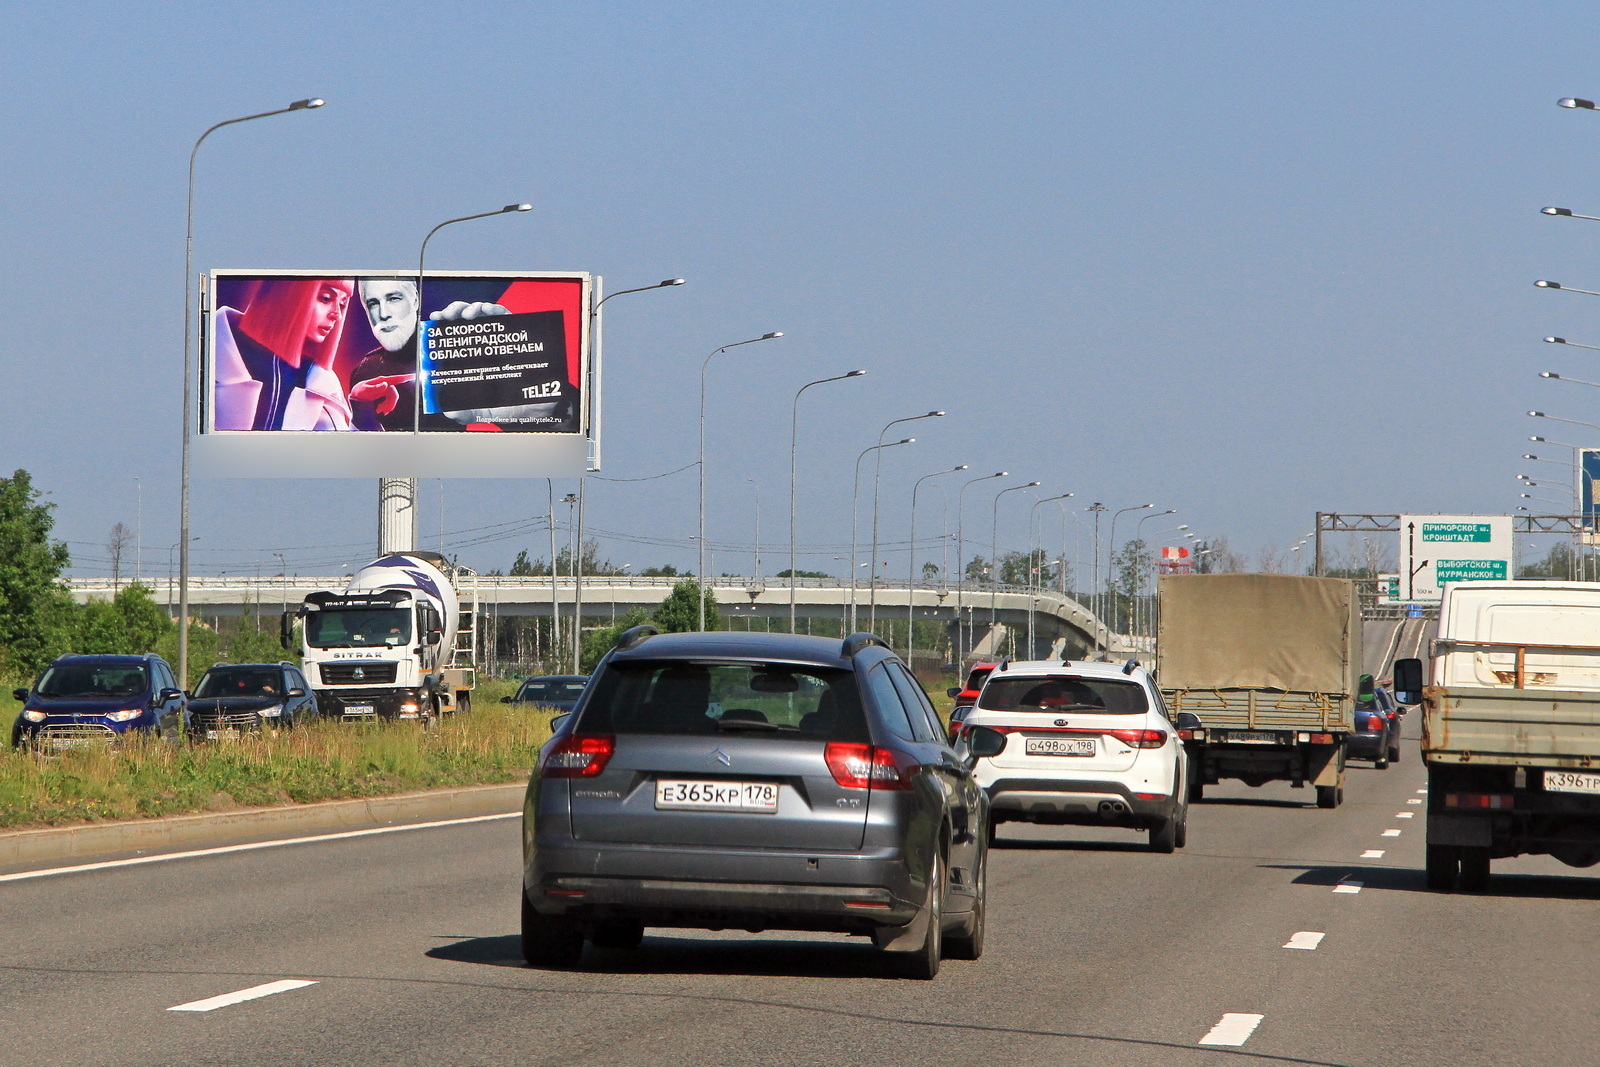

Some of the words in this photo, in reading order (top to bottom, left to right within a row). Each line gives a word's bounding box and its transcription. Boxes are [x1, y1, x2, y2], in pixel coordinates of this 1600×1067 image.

[428, 328, 442, 338] ЗА
[445, 323, 505, 337] СКОРОСТЬ
[429, 340, 436, 349] В
[439, 330, 528, 349] ЛЕНИГРАДСКОЙ
[430, 347, 482, 361] ОБЛАСТИ
[485, 342, 544, 358] ОТВЕЧАЕМ
[431, 369, 462, 377] Качество
[464, 365, 500, 377] интернета
[502, 362, 549, 372] обеспечивает
[431, 374, 484, 385] искусственный
[486, 371, 522, 381] интеллект
[522, 380, 562, 399] TELE2
[476, 415, 509, 424] Подробнее
[1423, 524, 1478, 532] ПРИМОРСКОЕ
[1423, 533, 1475, 542] КРОНШТАДТ
[1437, 560, 1491, 569] ВЫБОРГСКОЕ
[1438, 570, 1494, 579] МУРМАНСКОЕ
[334, 651, 382, 659] SITRAK
[1077, 741, 1092, 750] 198
[744, 785, 772, 800] 178
